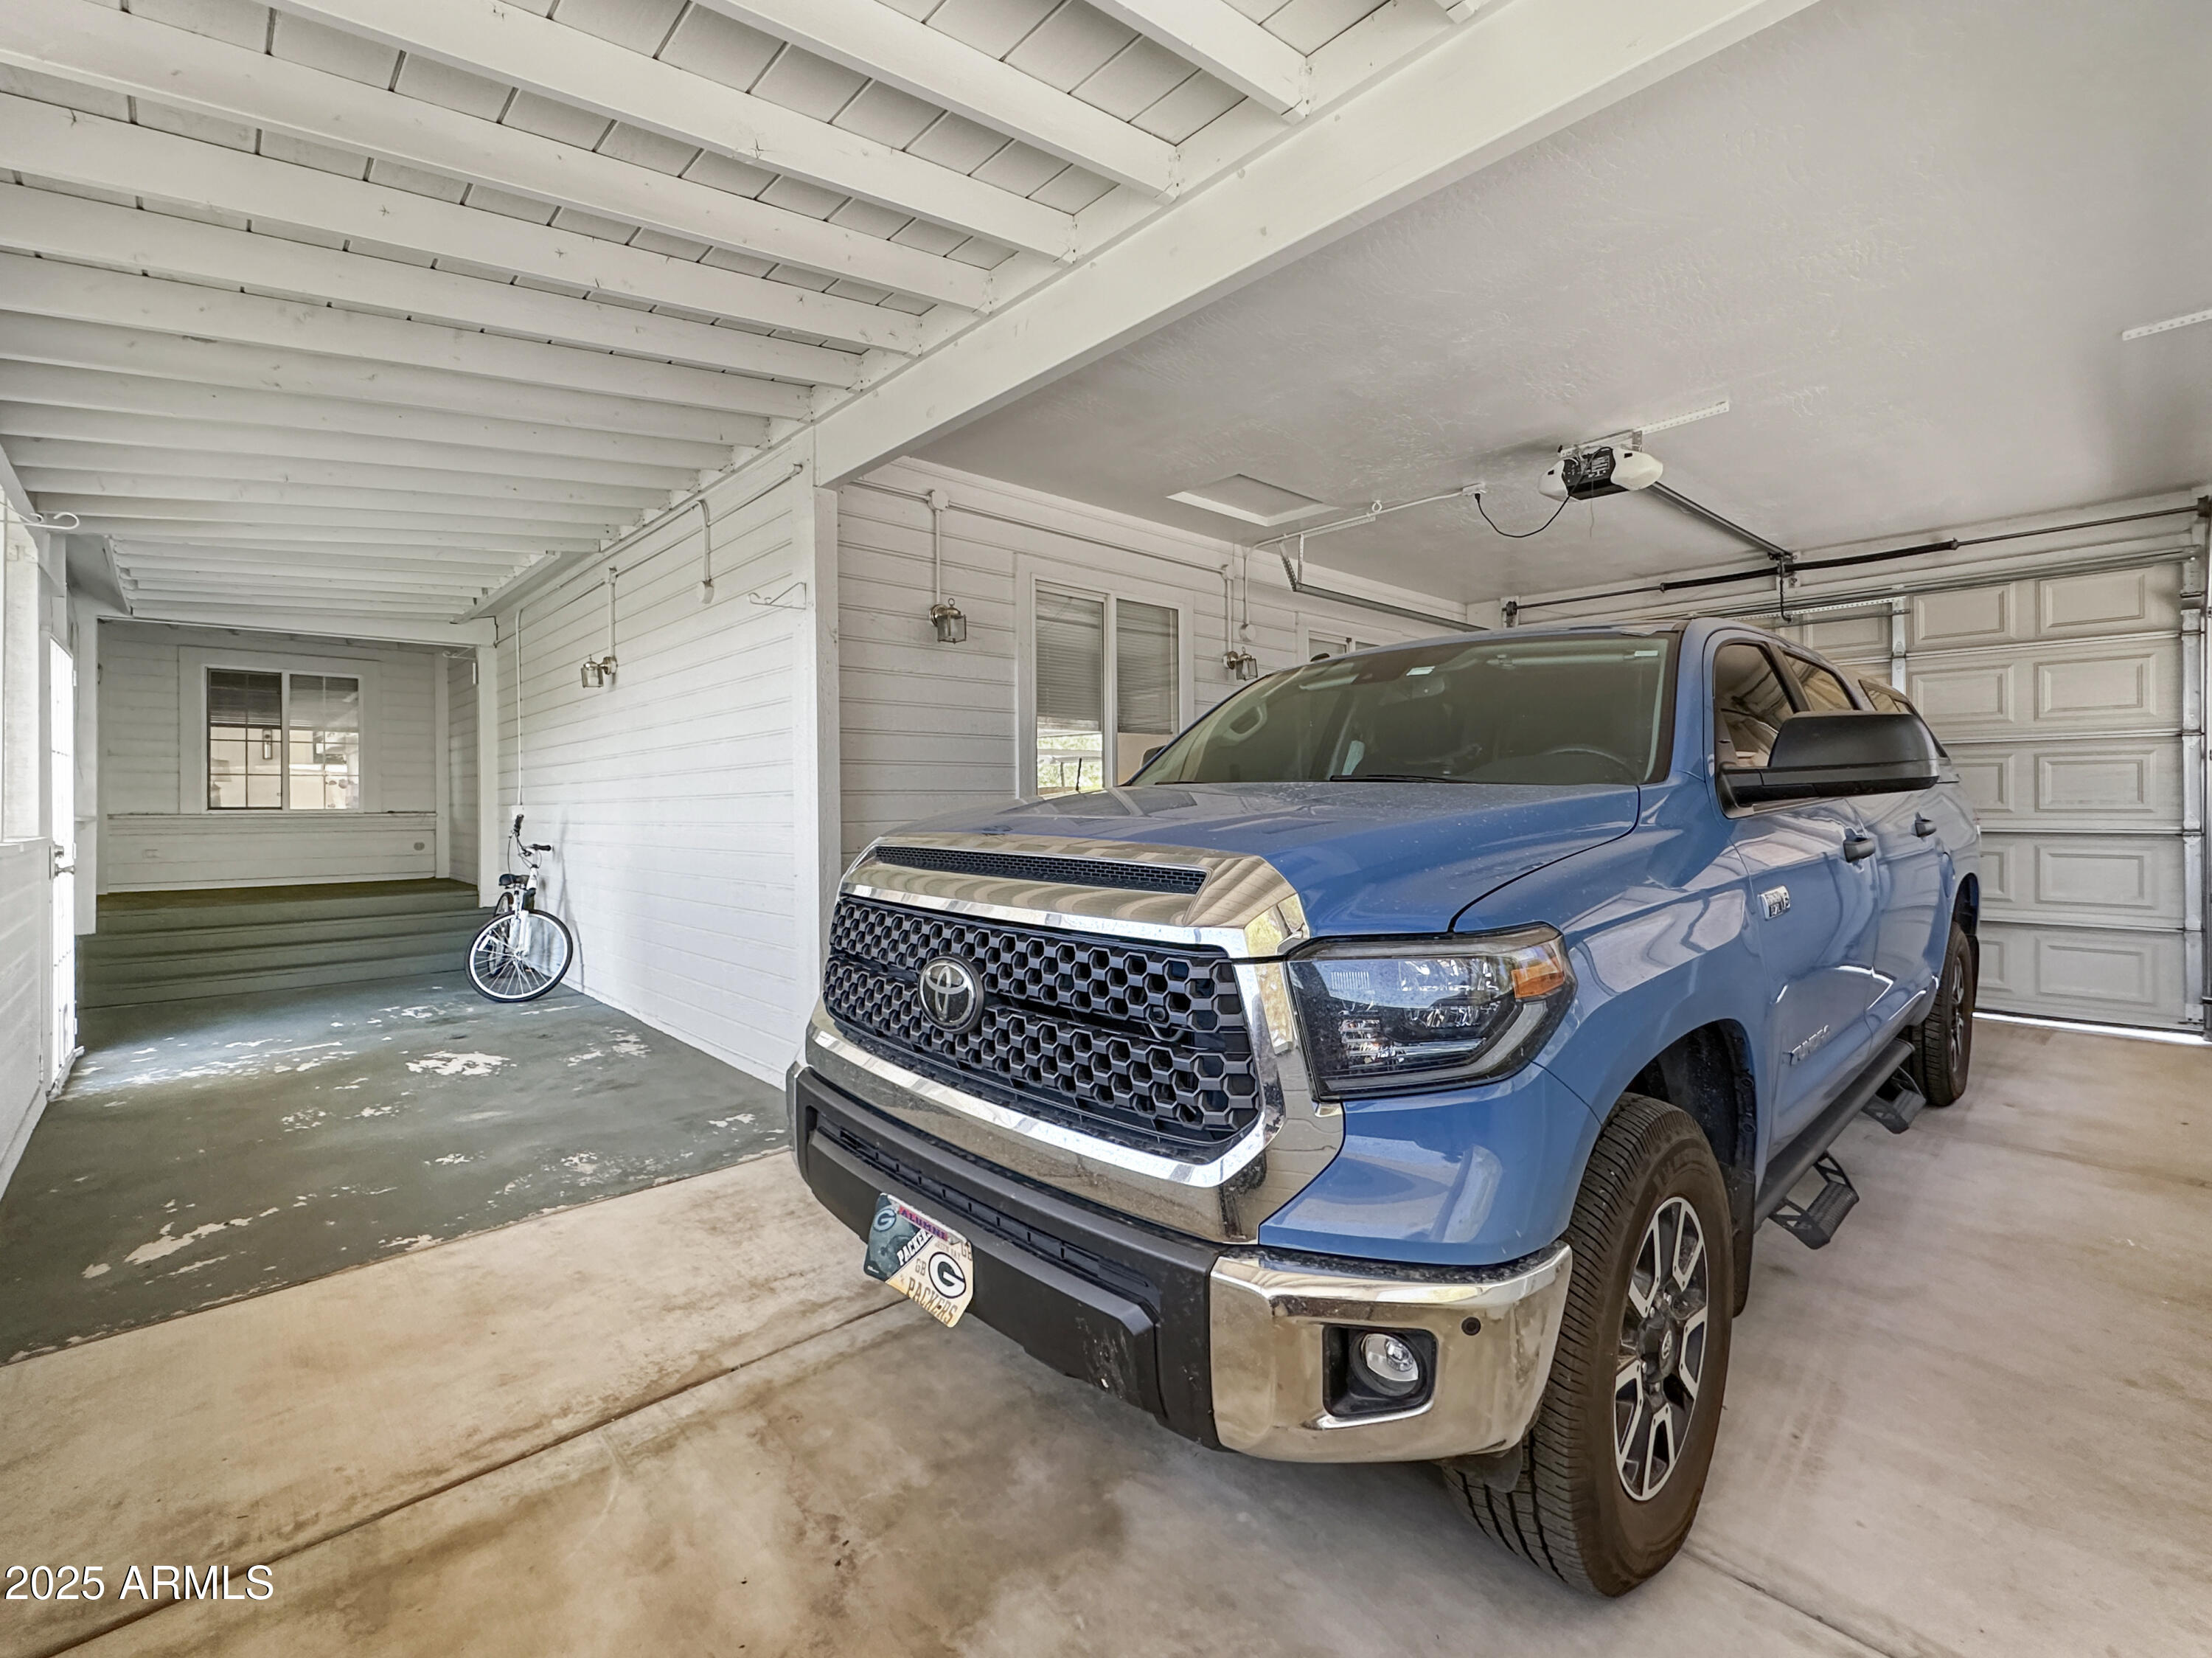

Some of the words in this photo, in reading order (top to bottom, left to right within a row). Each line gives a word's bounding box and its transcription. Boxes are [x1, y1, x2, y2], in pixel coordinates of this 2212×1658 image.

[900, 1209, 947, 1240] ALUMNI
[915, 1258, 927, 1277] GB
[907, 1277, 958, 1325] PACKERS
